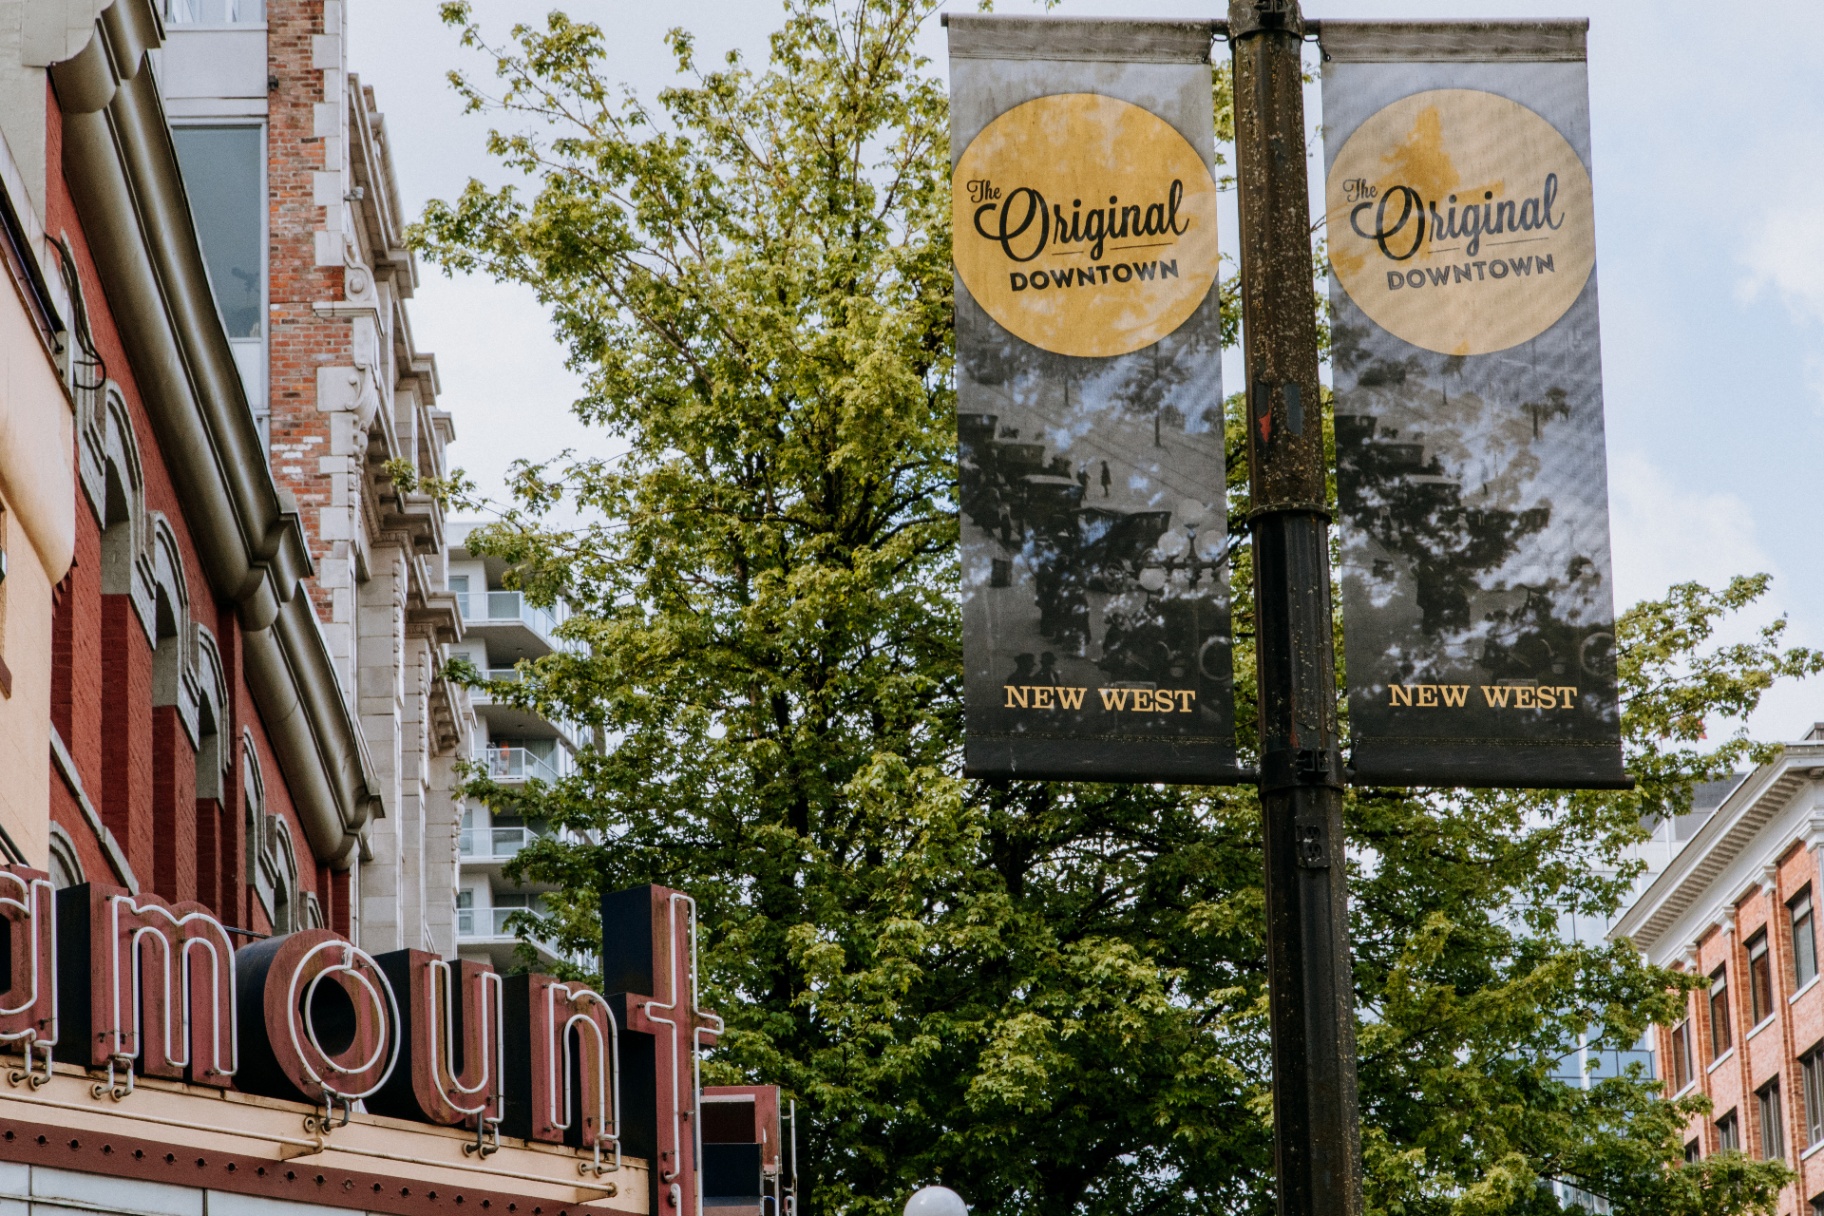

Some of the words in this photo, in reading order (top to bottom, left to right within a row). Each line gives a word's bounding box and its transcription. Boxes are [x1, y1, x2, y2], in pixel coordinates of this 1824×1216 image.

[966, 179, 1002, 203] The
[1342, 177, 1378, 203] The
[973, 178, 1190, 262] Original
[1350, 172, 1565, 261] Original
[1009, 258, 1180, 292] DOWNTOWN
[1386, 253, 1556, 291] DOWNTOWN
[1003, 684, 1088, 711] NEW
[1097, 687, 1196, 713] WEST
[1387, 683, 1471, 708] NEW
[1480, 684, 1578, 710] WEST
